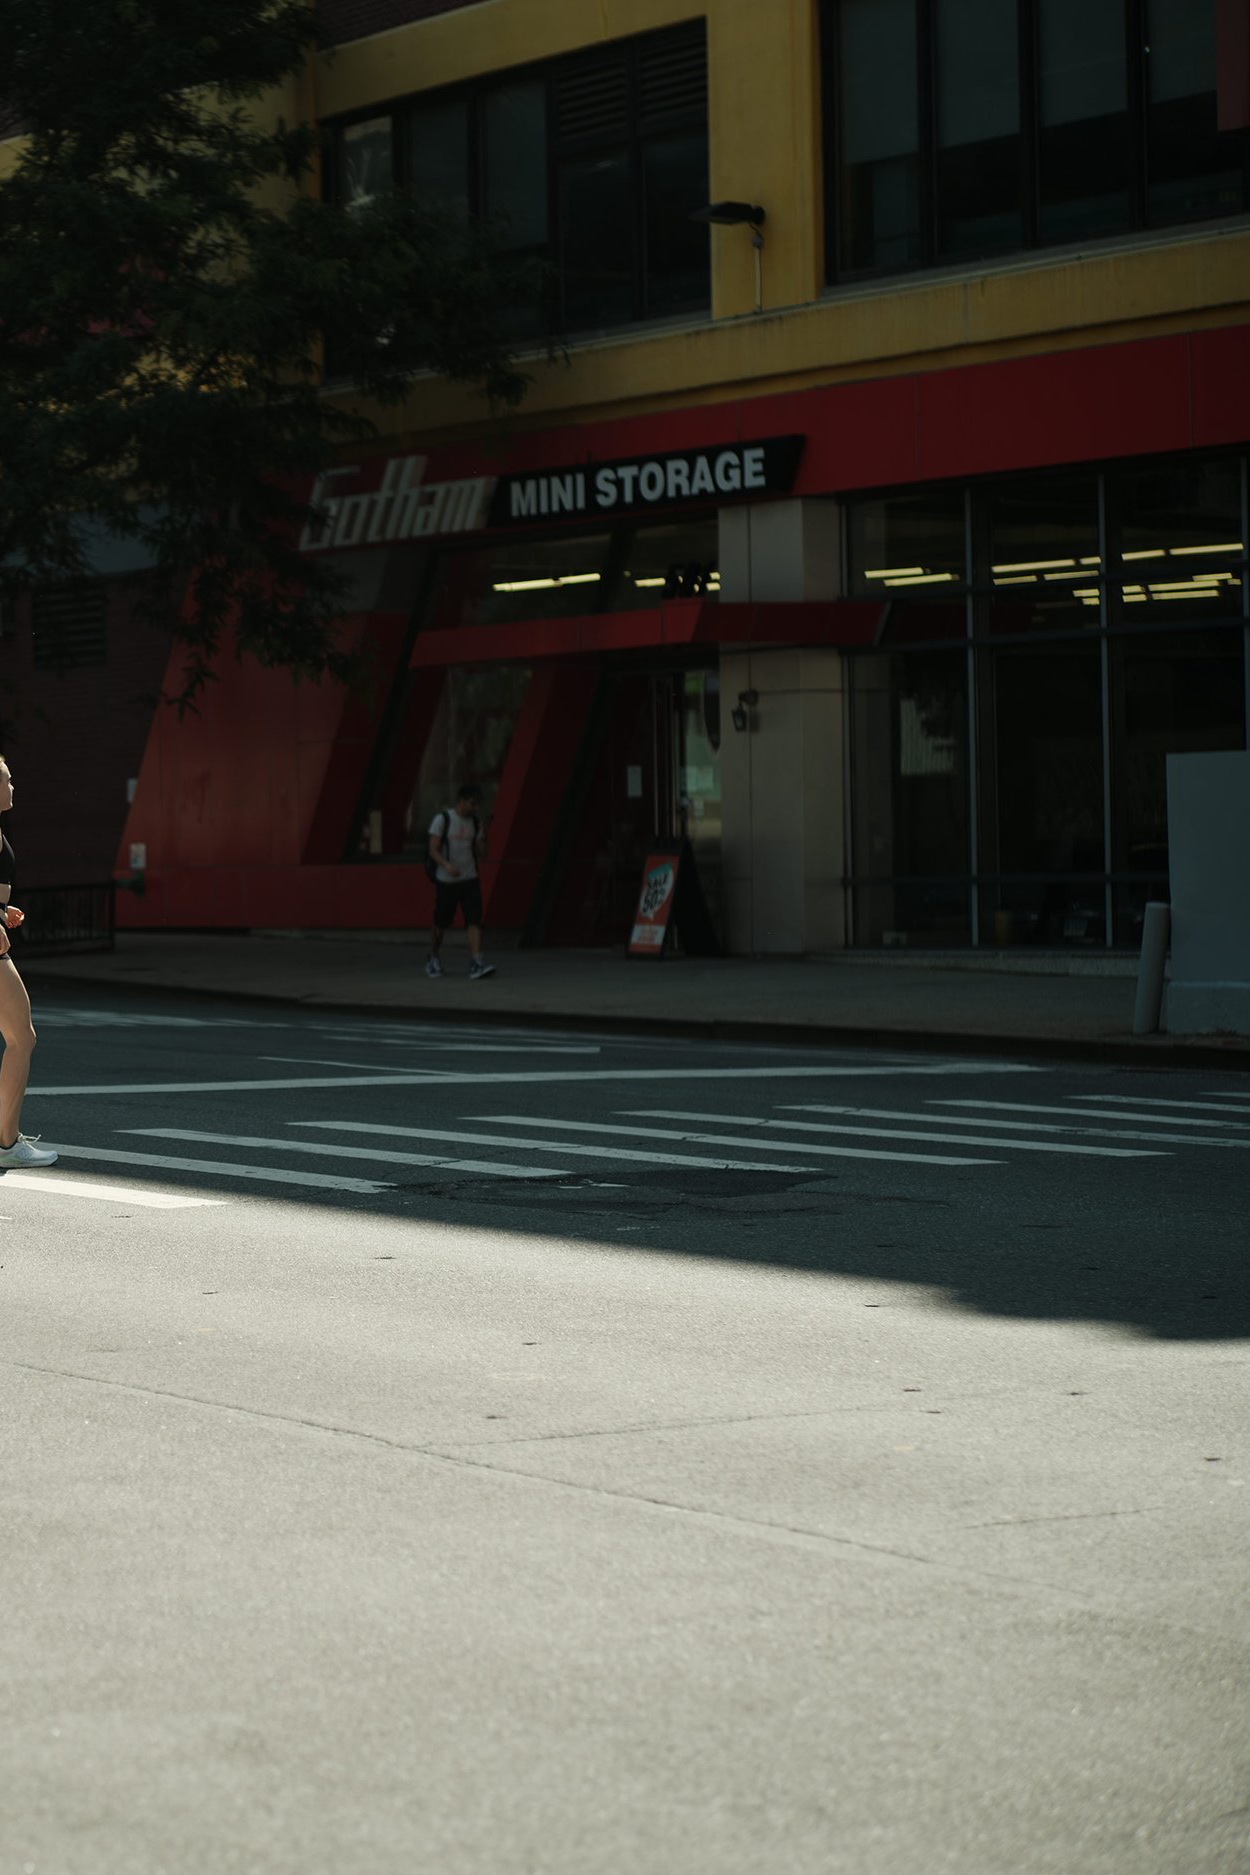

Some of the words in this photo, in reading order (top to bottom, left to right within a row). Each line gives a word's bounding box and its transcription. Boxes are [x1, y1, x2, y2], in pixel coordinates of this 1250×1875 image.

[298, 455, 492, 552] Gotham
[509, 474, 587, 518] MINI
[595, 446, 767, 508] STORAGE
